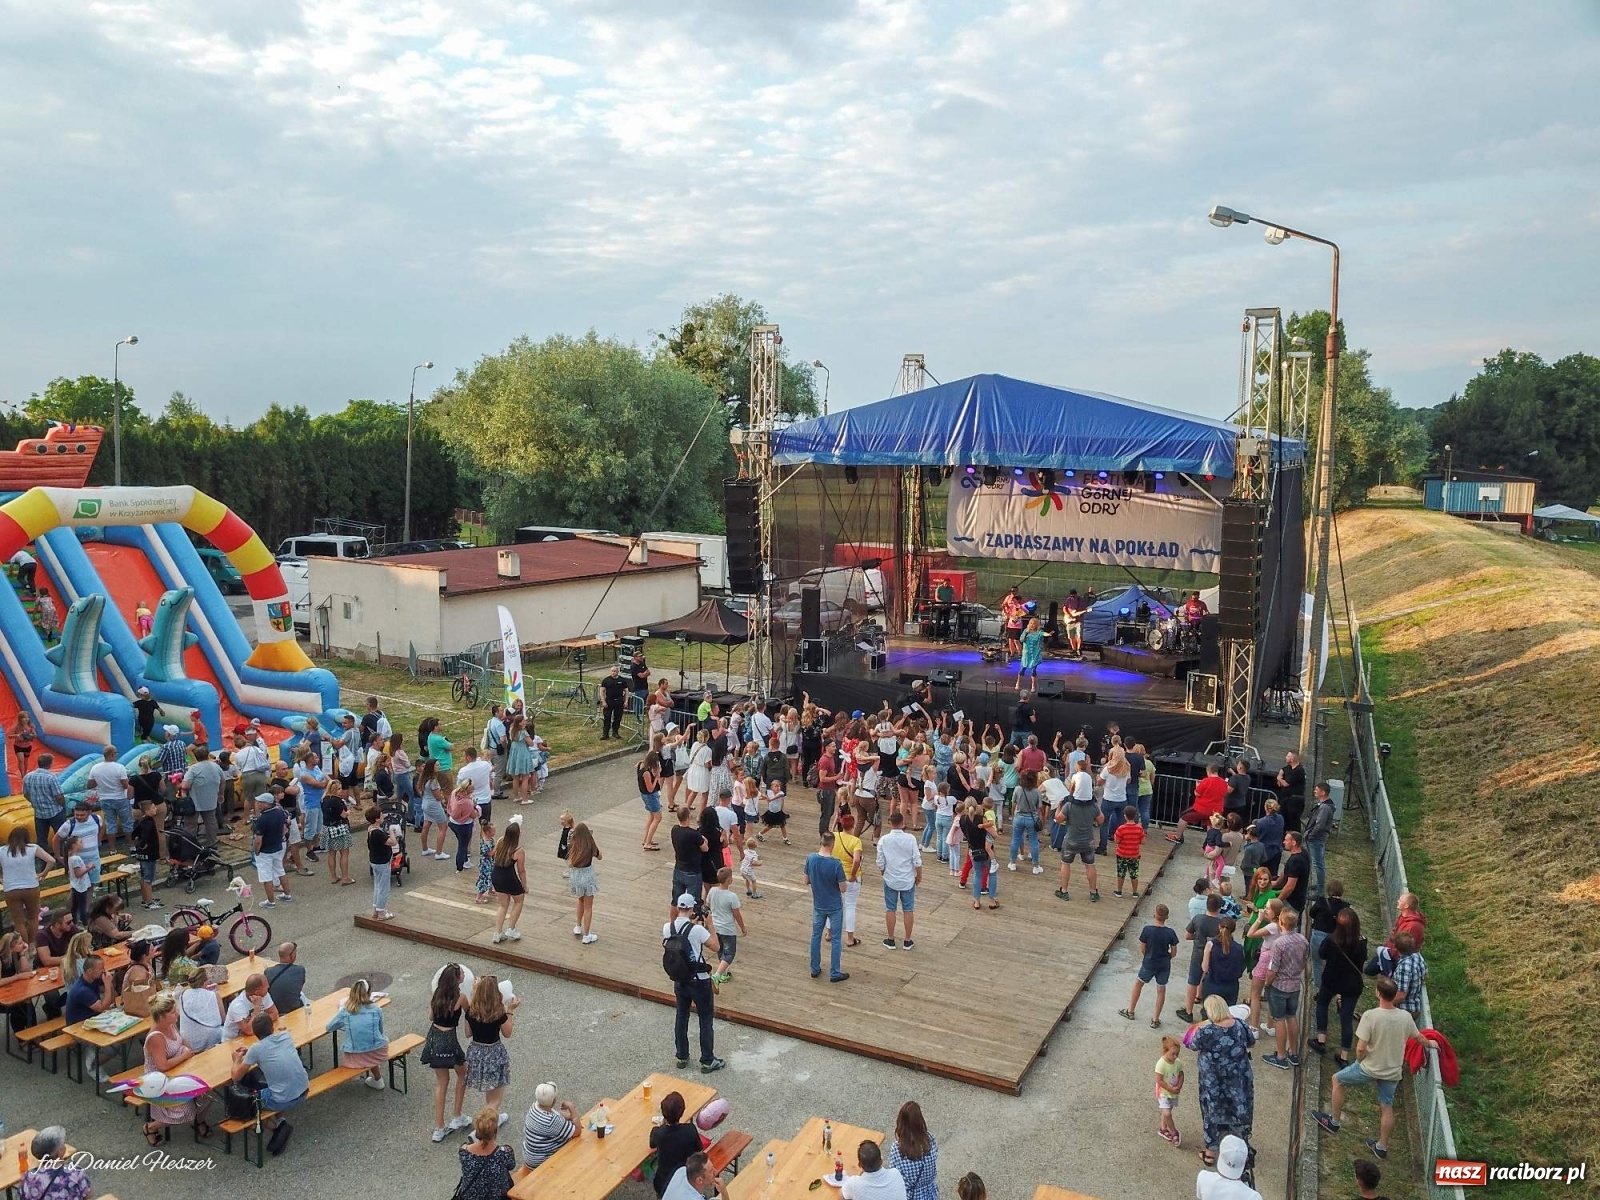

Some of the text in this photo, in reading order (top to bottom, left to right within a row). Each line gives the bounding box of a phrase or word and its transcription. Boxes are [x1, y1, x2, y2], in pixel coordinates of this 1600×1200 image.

[1083, 472, 1145, 486] FESTIA
[109, 499, 129, 508] Bank
[1079, 501, 1121, 515] ODRY
[986, 533, 1180, 558] ZAPRASZAMY NA POKŁAD
